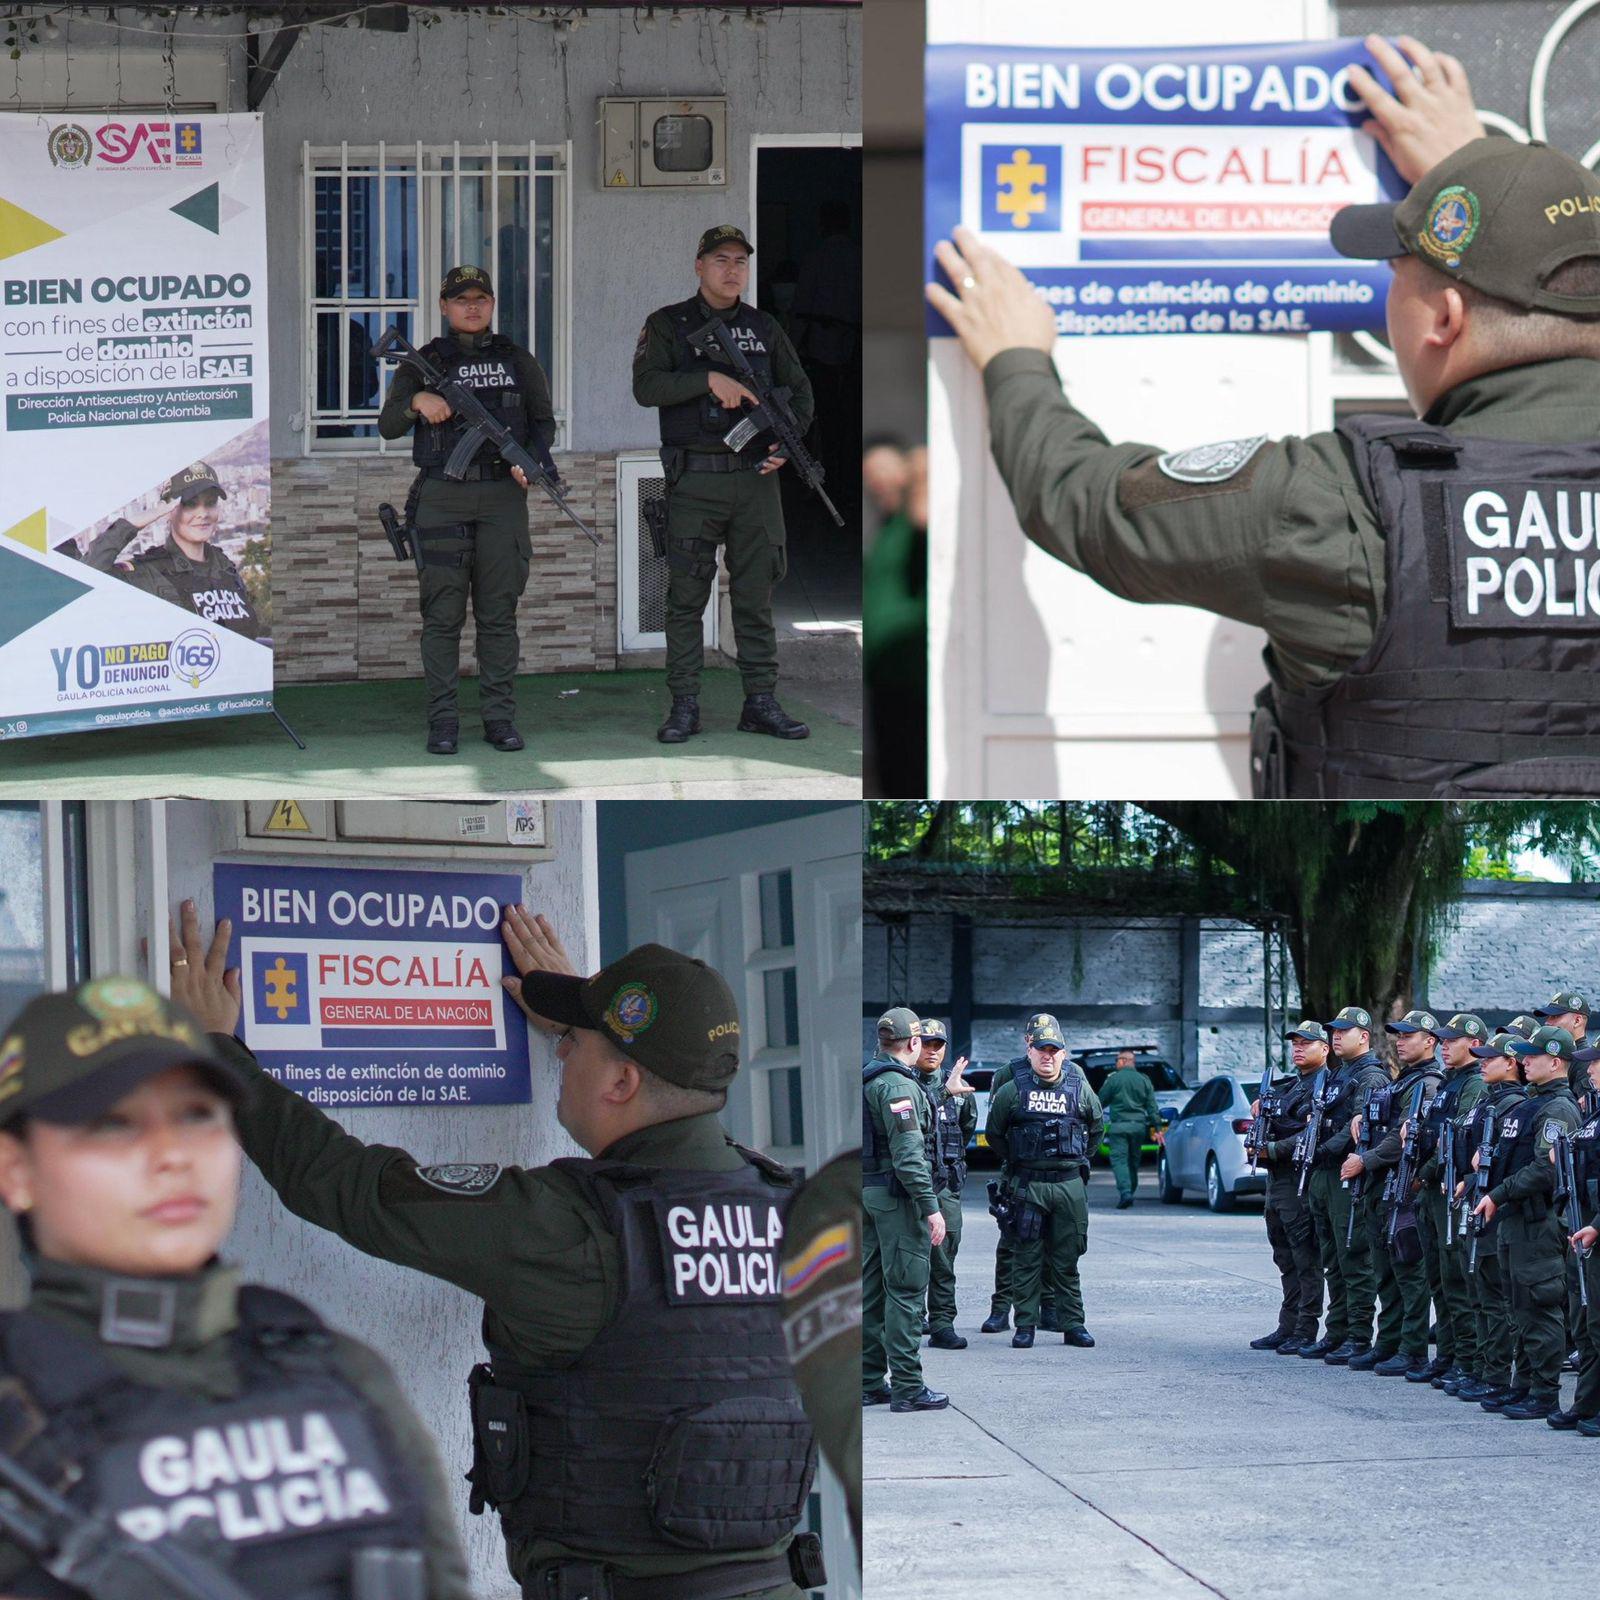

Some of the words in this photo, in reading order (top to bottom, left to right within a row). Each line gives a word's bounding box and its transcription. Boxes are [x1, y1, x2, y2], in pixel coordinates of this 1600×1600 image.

[965, 64, 1080, 110] BIEN
[95, 123, 171, 164] SAE
[1081, 138, 1351, 186] FISCALÍA
[1085, 207, 1191, 228] GENERAL
[1194, 207, 1225, 228] DE
[1231, 207, 1259, 228] LA
[1263, 203, 1333, 228] NACIÓ
[4, 279, 82, 306] BIEN
[91, 272, 252, 303] OCUPADO
[1079, 280, 1113, 304] de
[1118, 279, 1230, 304] extinción
[1234, 280, 1269, 304] de
[1273, 279, 1374, 304] dominio
[4, 321, 45, 336] con
[52, 314, 107, 335] fines
[111, 313, 139, 332] de
[143, 308, 251, 332] extinción
[1056, 307, 1186, 335] disposición
[1190, 310, 1224, 332] de
[1229, 310, 1254, 331] la
[1258, 309, 1311, 331] SAE.
[66, 342, 93, 361] de
[98, 334, 192, 360] dominio
[6, 372, 24, 387] a
[24, 363, 144, 389] disposición
[150, 361, 177, 380] de
[182, 360, 198, 378] la
[202, 357, 248, 379] SAE
[458, 363, 506, 377] GAULA
[18, 395, 74, 410] Dirección
[75, 391, 155, 407] Antisecuestro
[156, 393, 163, 405] y
[164, 388, 238, 402] Antiextorsión
[48, 409, 86, 424] Policía
[88, 406, 139, 421] Nacional
[141, 405, 156, 419] de
[157, 404, 211, 418] Colombia
[1463, 490, 1600, 550] GAU
[202, 603, 250, 621] GAULA
[104, 646, 126, 664] NO
[129, 643, 167, 662] PAGO
[176, 645, 214, 667] 165
[50, 644, 100, 692] YO
[104, 664, 169, 684] DENUNCIO
[56, 692, 90, 702] GAULA
[126, 684, 172, 695] NACIONAL
[242, 887, 317, 925] BIEN
[328, 889, 500, 930] OCUPADO
[318, 949, 490, 988] FISCALÍA
[324, 1005, 392, 1020] GENERAL
[394, 1006, 415, 1020] DE
[417, 1006, 435, 1020] LA
[436, 1001, 488, 1021] NACIÓN
[285, 1063, 322, 1080] fines
[326, 1063, 346, 1080] de
[350, 1062, 420, 1080] extinción
[424, 1063, 444, 1079] de
[447, 1062, 506, 1079] dominio
[308, 1085, 393, 1106] disposición
[397, 1086, 417, 1102] de
[421, 1086, 435, 1101] la
[439, 1085, 471, 1102] SAE.
[1029, 1091, 1067, 1104] GAULA
[668, 1205, 783, 1249] GAULA
[674, 1253, 782, 1297] POLICI
[138, 1411, 347, 1499] GAULA
